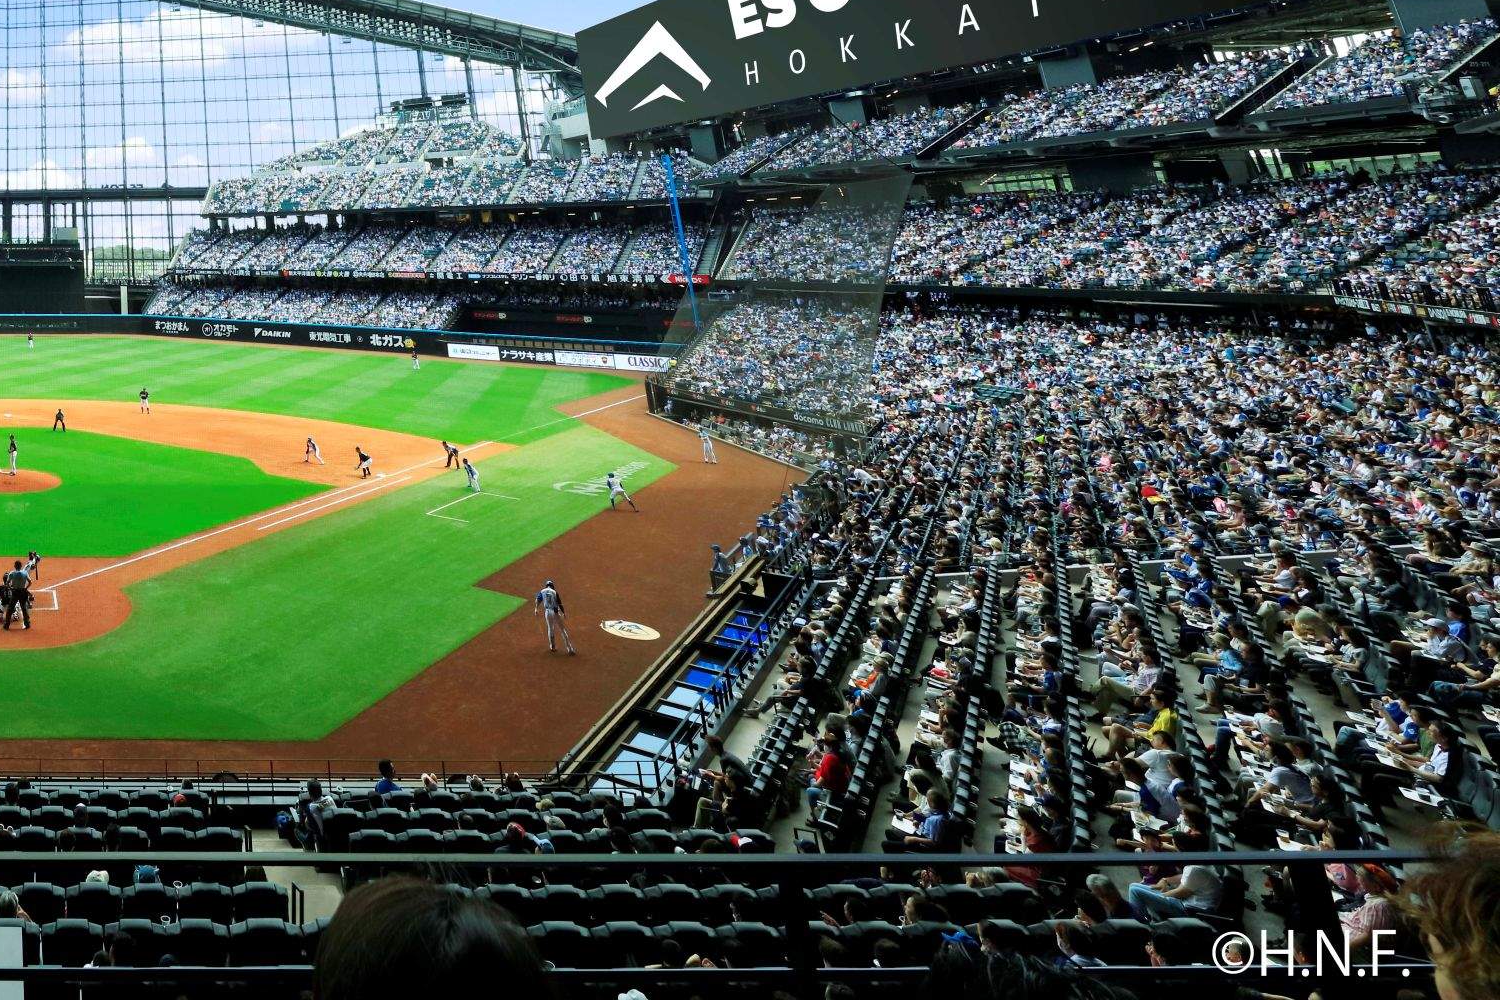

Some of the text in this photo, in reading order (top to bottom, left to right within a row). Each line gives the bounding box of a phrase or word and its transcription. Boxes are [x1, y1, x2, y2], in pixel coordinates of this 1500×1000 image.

[213, 323, 240, 334] オカモト
[261, 330, 292, 338] DAIKIN
[369, 333, 405, 348] 北ガス
[627, 355, 663, 368] CLASSIC
[793, 411, 824, 426] docomo
